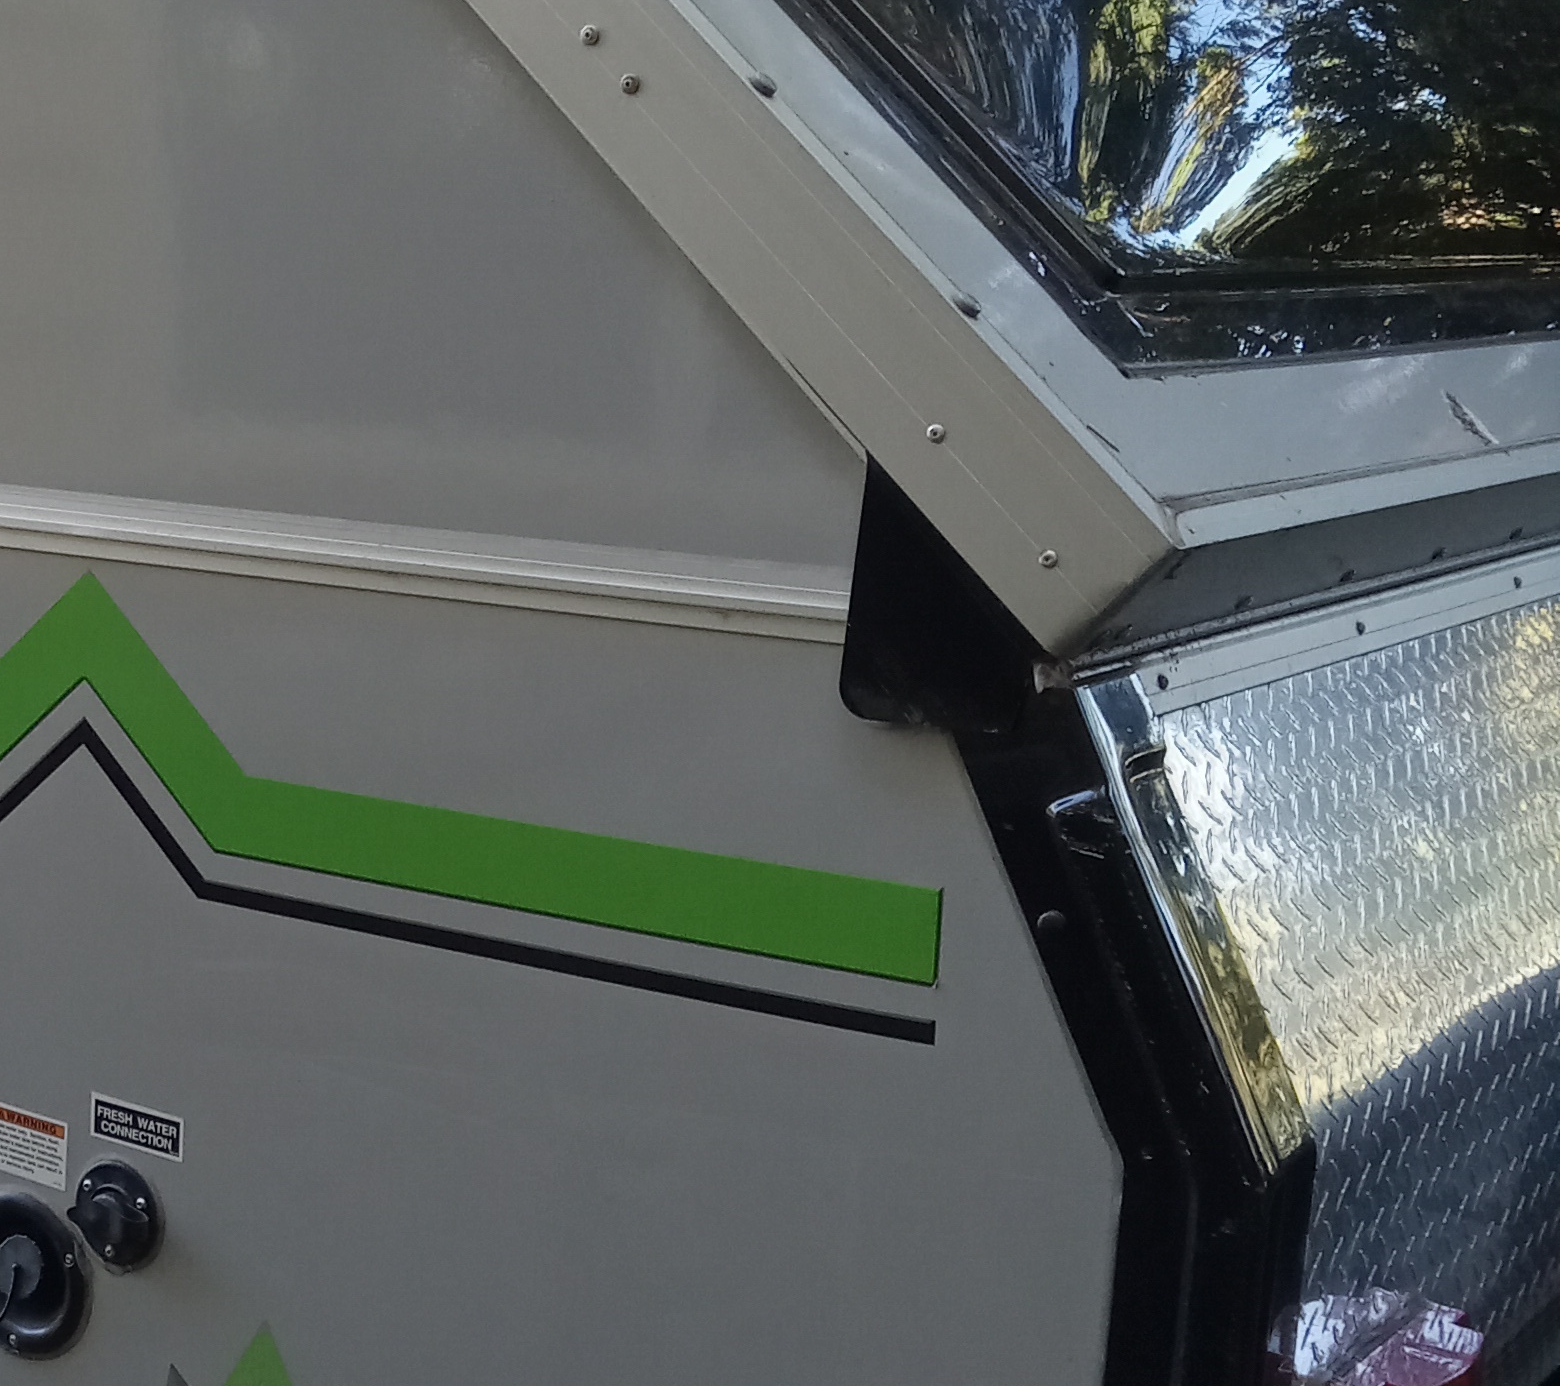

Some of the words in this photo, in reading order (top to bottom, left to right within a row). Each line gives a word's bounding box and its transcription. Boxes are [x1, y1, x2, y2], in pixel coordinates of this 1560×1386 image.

[7, 1111, 57, 1135] WARNING
[97, 1105, 133, 1126] FRESH
[137, 1116, 177, 1139] WATER
[100, 1121, 172, 1151] CONNECTION
